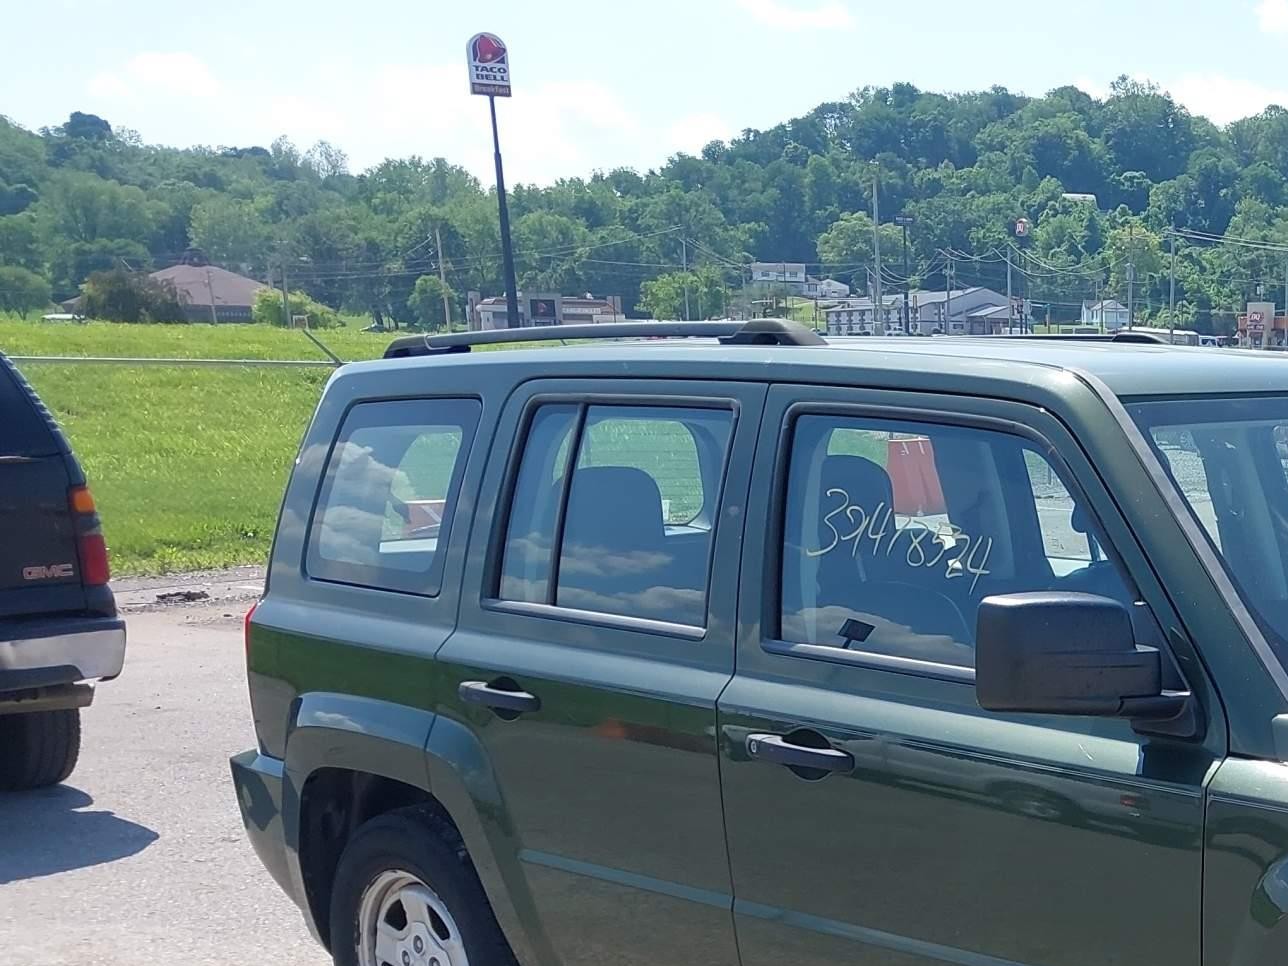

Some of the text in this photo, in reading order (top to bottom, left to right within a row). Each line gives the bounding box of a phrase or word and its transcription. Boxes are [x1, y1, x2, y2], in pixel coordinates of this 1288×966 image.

[472, 65, 507, 74] TACO
[475, 73, 508, 82] BELL
[806, 488, 993, 595] 39478524
[22, 563, 74, 580] GMC
